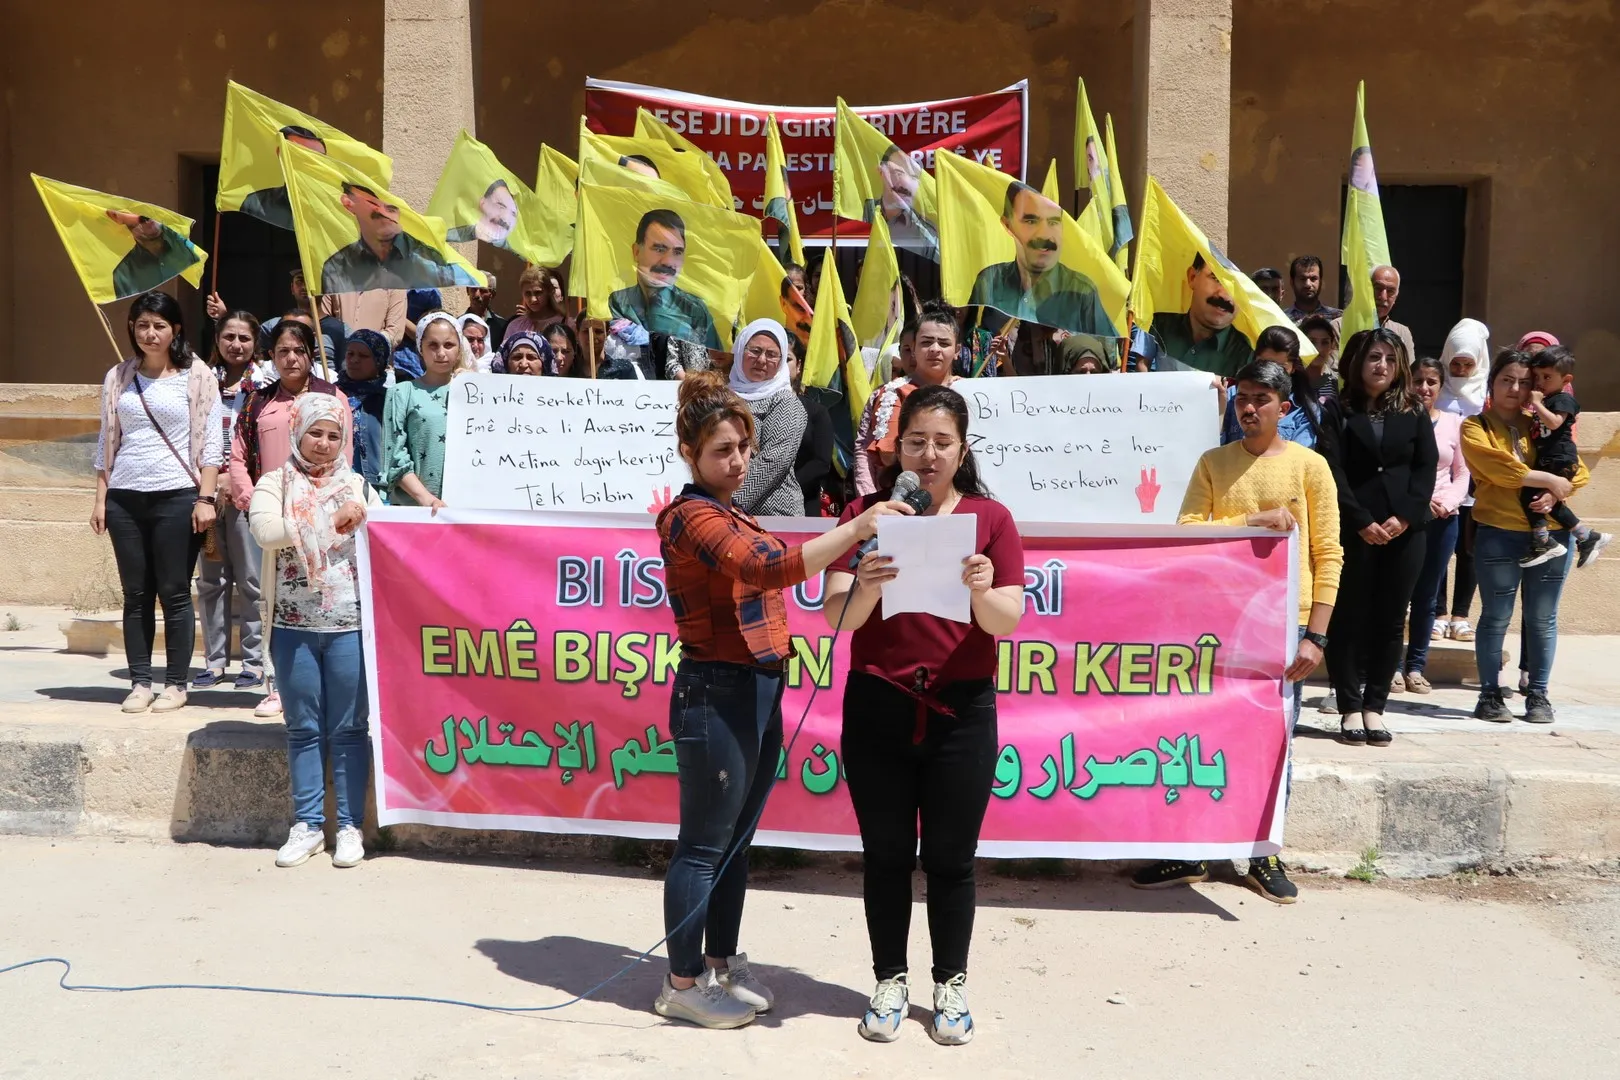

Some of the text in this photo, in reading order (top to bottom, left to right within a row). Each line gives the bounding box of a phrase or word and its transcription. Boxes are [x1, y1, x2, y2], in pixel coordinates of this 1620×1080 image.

[645, 109, 704, 135] ESE
[710, 111, 731, 137] JI
[464, 382, 484, 405] Bi
[492, 383, 525, 405] rihê
[537, 387, 625, 408] serkeftina
[972, 389, 1184, 420] Bi Berxwedana bazên
[466, 417, 495, 435] Emê
[561, 419, 572, 434] li
[471, 449, 486, 467] û
[498, 449, 560, 469] Metîna
[966, 433, 1054, 467] Zegrosan
[1131, 436, 1165, 453] her
[514, 481, 634, 511] Têk bibin
[556, 555, 604, 607] BI
[420, 619, 539, 681] EMÊ
[1073, 633, 1222, 696] KERÎ
